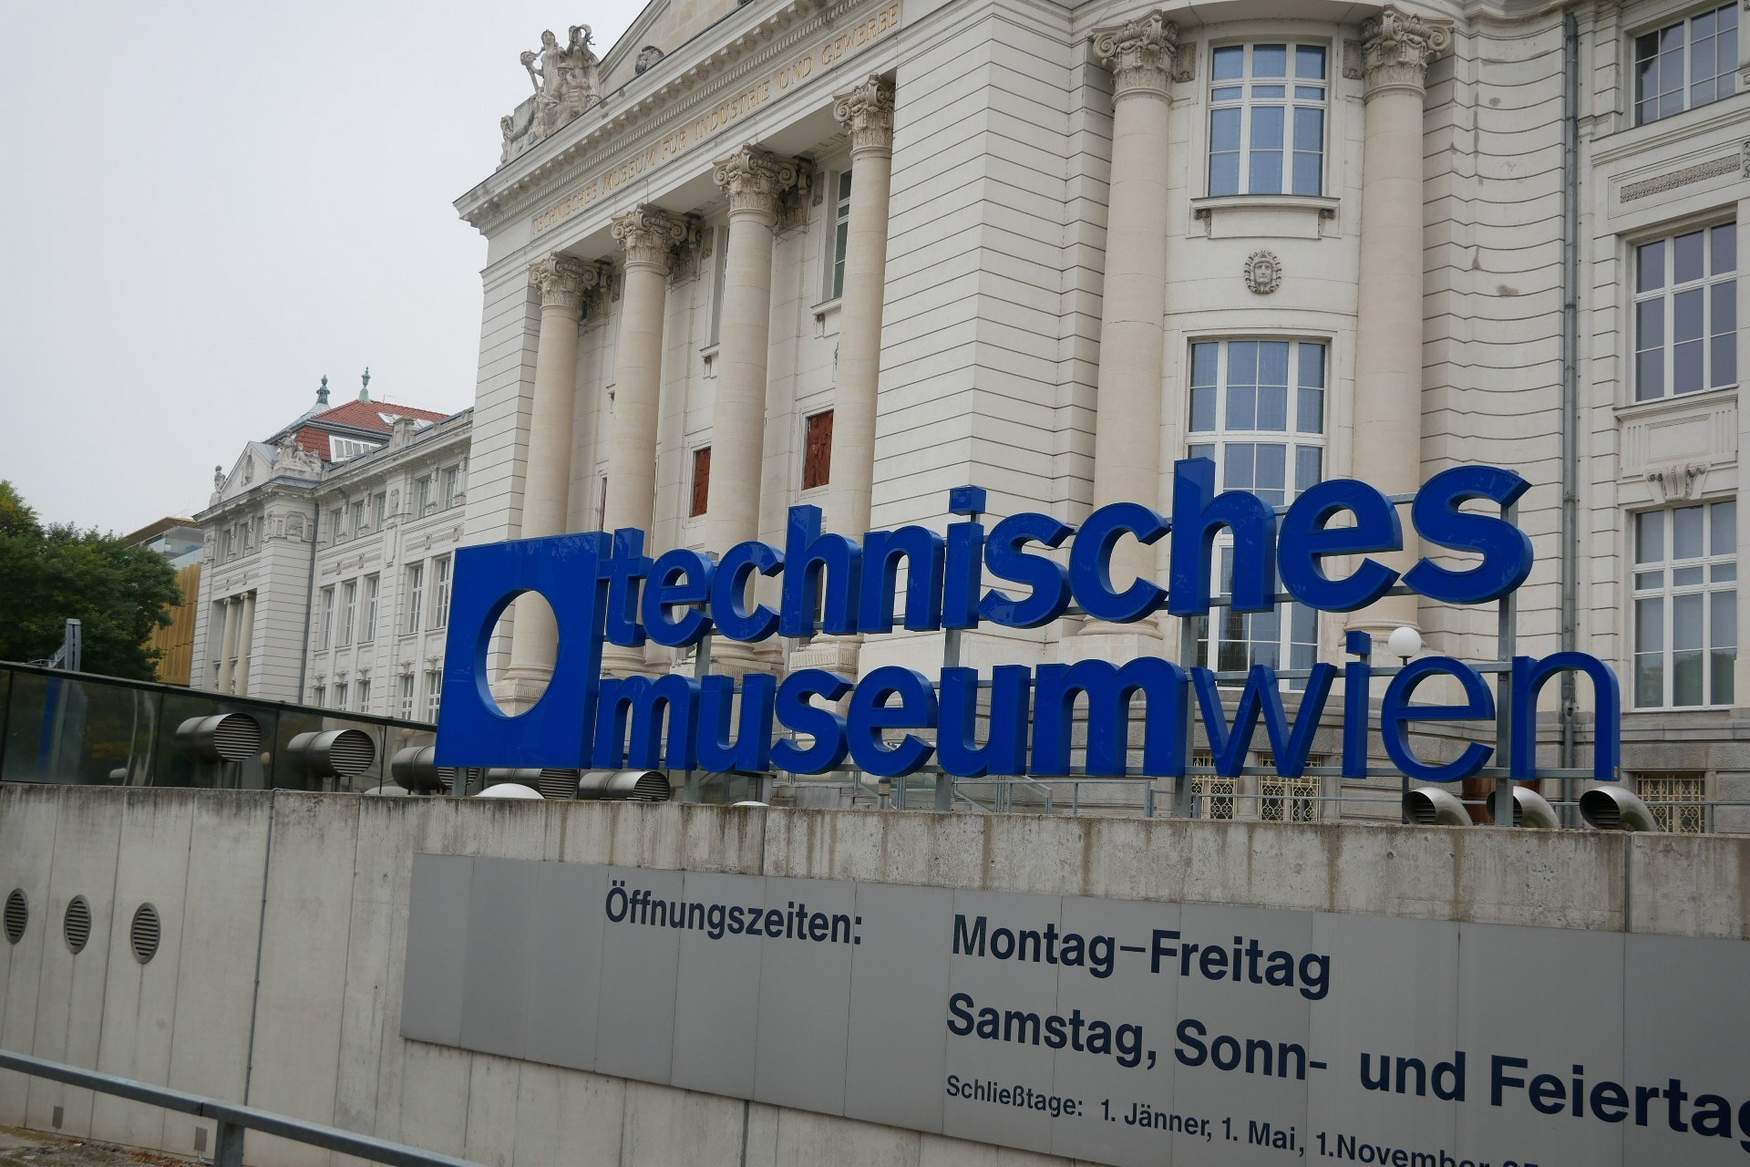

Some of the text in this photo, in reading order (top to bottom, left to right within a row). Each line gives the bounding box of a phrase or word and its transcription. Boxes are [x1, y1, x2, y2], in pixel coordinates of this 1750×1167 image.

[695, 80, 769, 141] INDUSTRIE
[776, 55, 815, 89] UND
[821, 3, 899, 65] GEWERBE
[601, 457, 1534, 647] technisches
[605, 880, 862, 944] Öffnungszeiten:
[947, 993, 1157, 1070] Samstag,
[1175, 1019, 1328, 1080] Sonn-
[1361, 1051, 1466, 1102] und
[946, 1075, 1083, 1117] Schließtage:
[1101, 1099, 1116, 1122] 1.
[1124, 1103, 1213, 1142] Jänner,
[1222, 1117, 1238, 1141] 1.
[1248, 1120, 1304, 1157] Mai,
